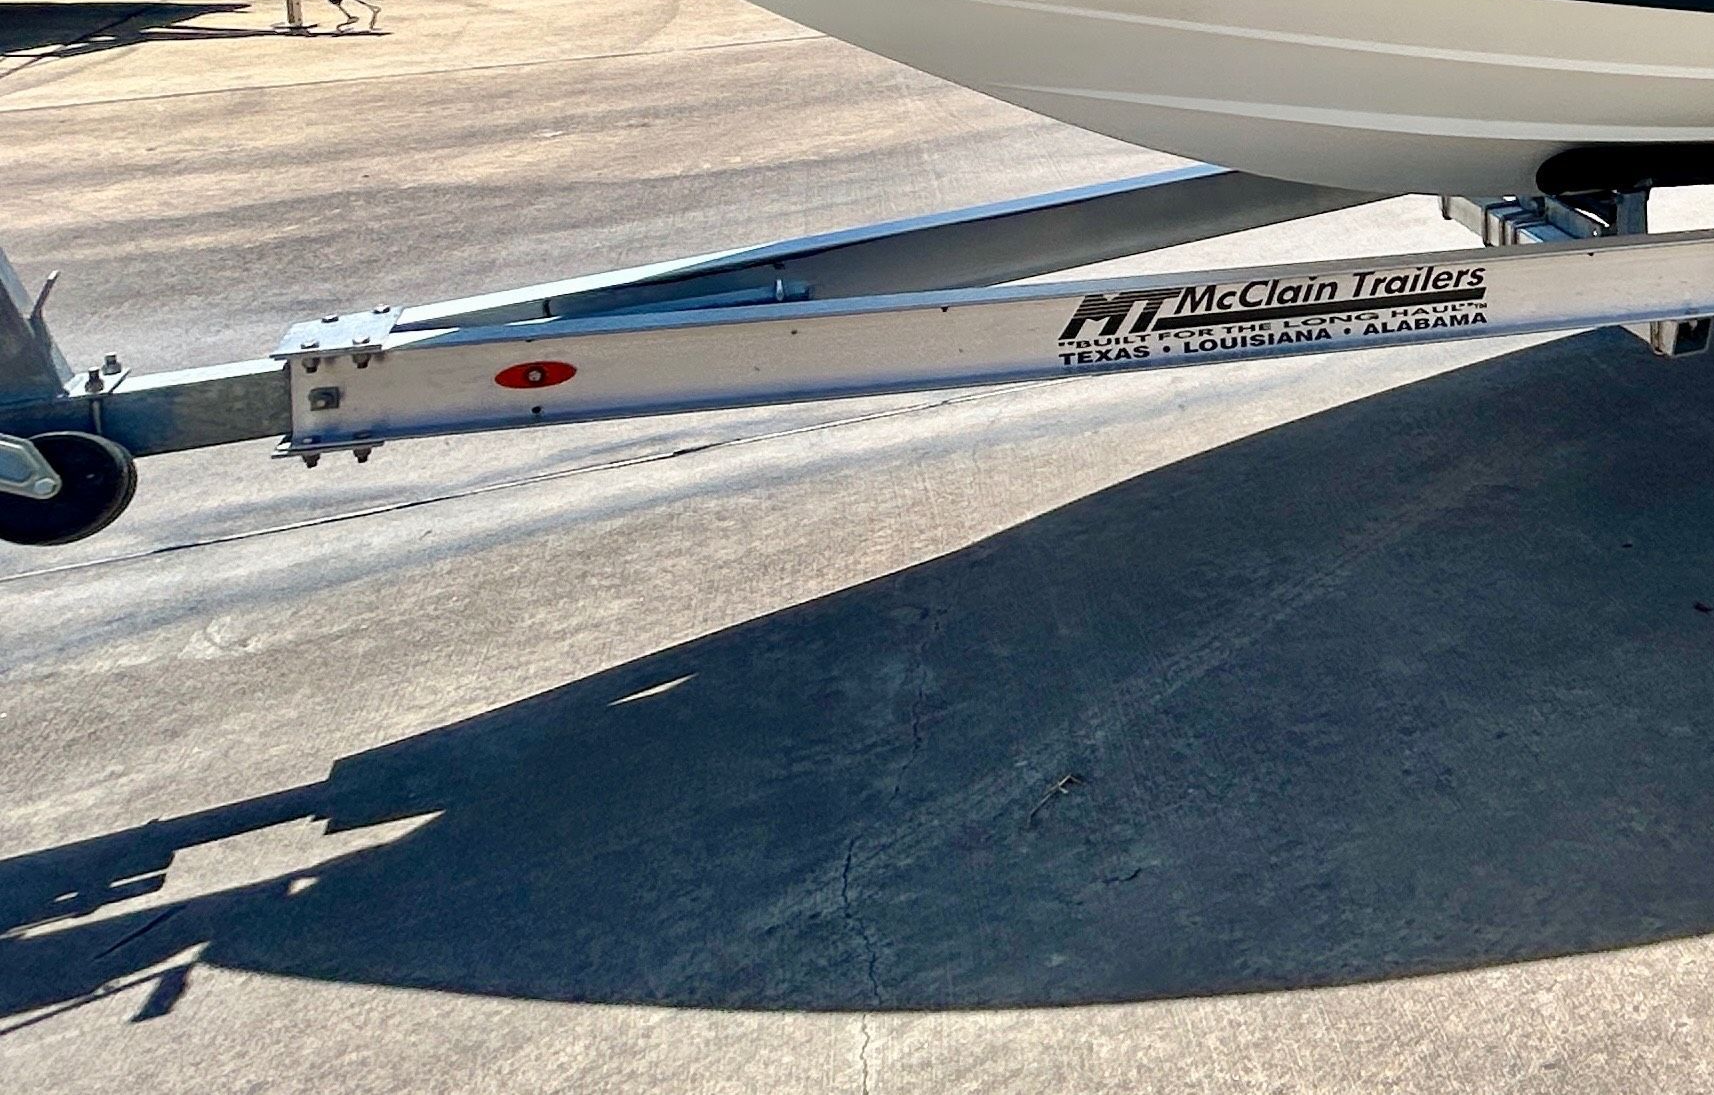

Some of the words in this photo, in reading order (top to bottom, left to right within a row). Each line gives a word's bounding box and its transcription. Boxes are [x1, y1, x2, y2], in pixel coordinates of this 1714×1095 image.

[1173, 276, 1338, 315] McClain
[1352, 266, 1486, 298] Trailers
[1058, 346, 1150, 366] TEXAS
[1184, 328, 1332, 353] LOUISIANA
[1363, 312, 1488, 336] ALABAMA
[1158, 328, 1214, 341] FOR
[1223, 322, 1272, 334] THE
[1284, 312, 1379, 328] LONG
